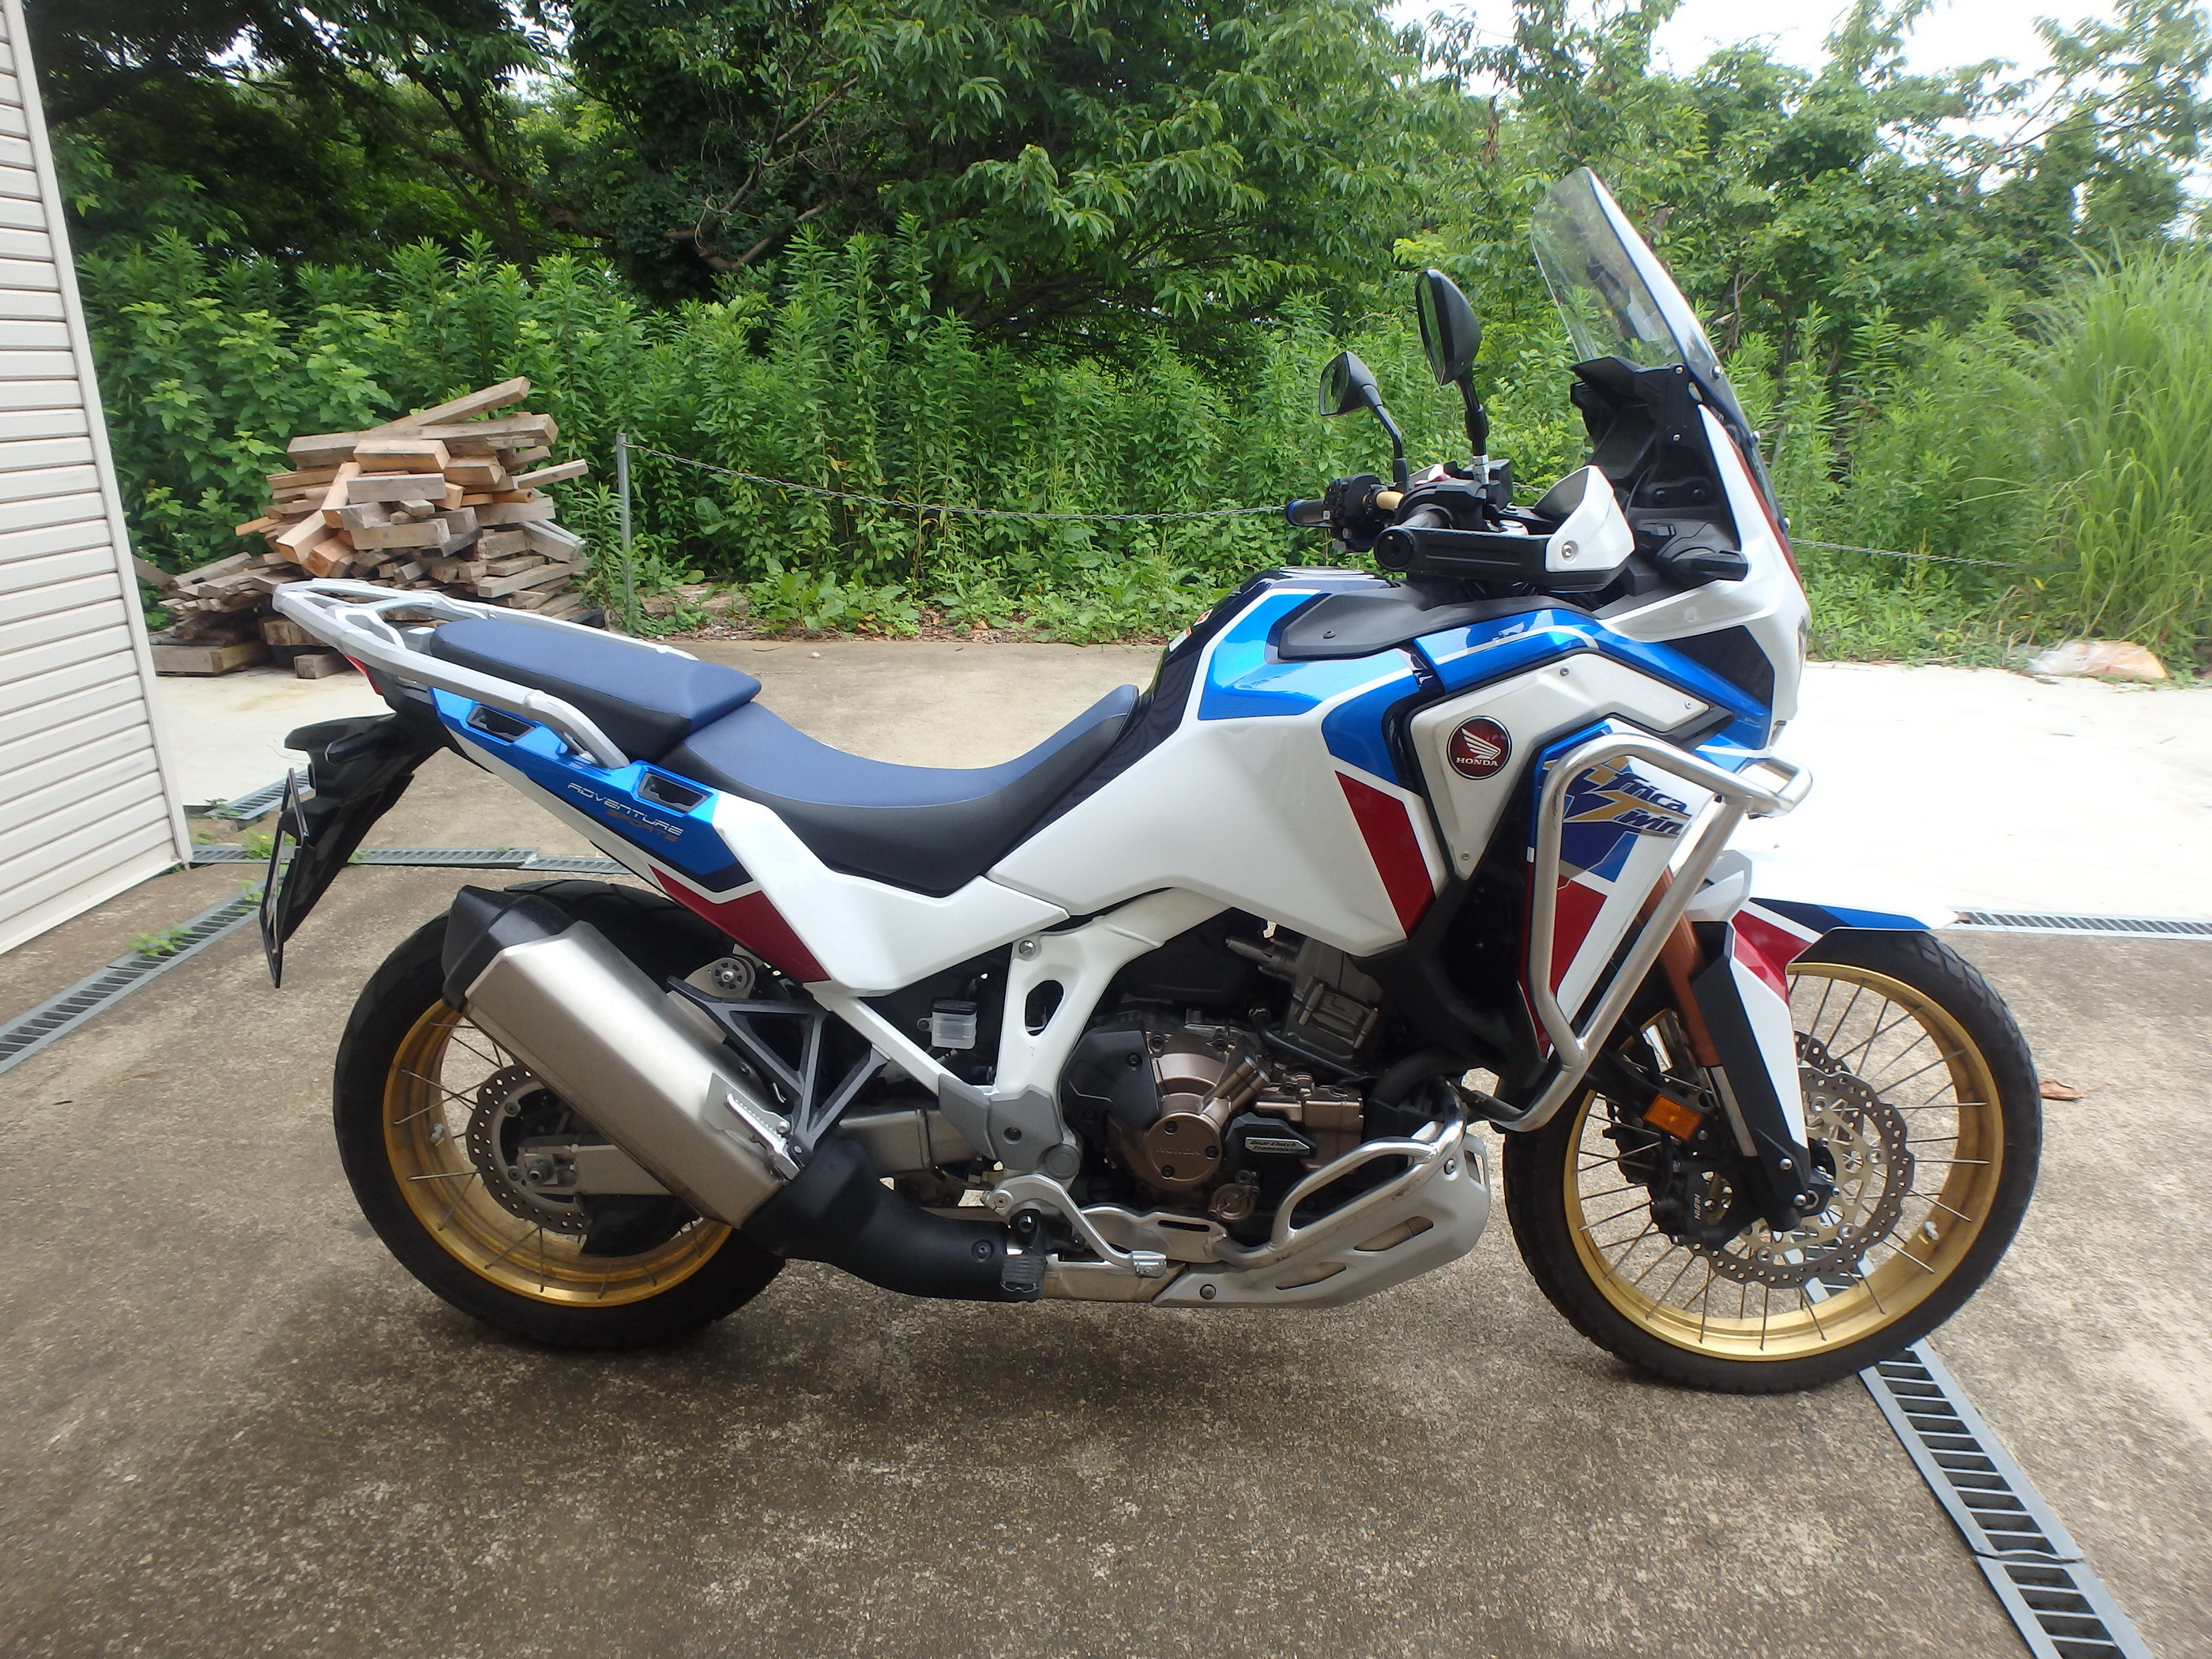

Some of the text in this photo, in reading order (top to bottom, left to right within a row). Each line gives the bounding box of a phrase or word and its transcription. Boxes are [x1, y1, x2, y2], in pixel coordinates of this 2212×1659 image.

[1455, 757, 1499, 767] HONDA
[566, 782, 684, 837] ADVENTURE
[606, 808, 679, 843] SPORTS
